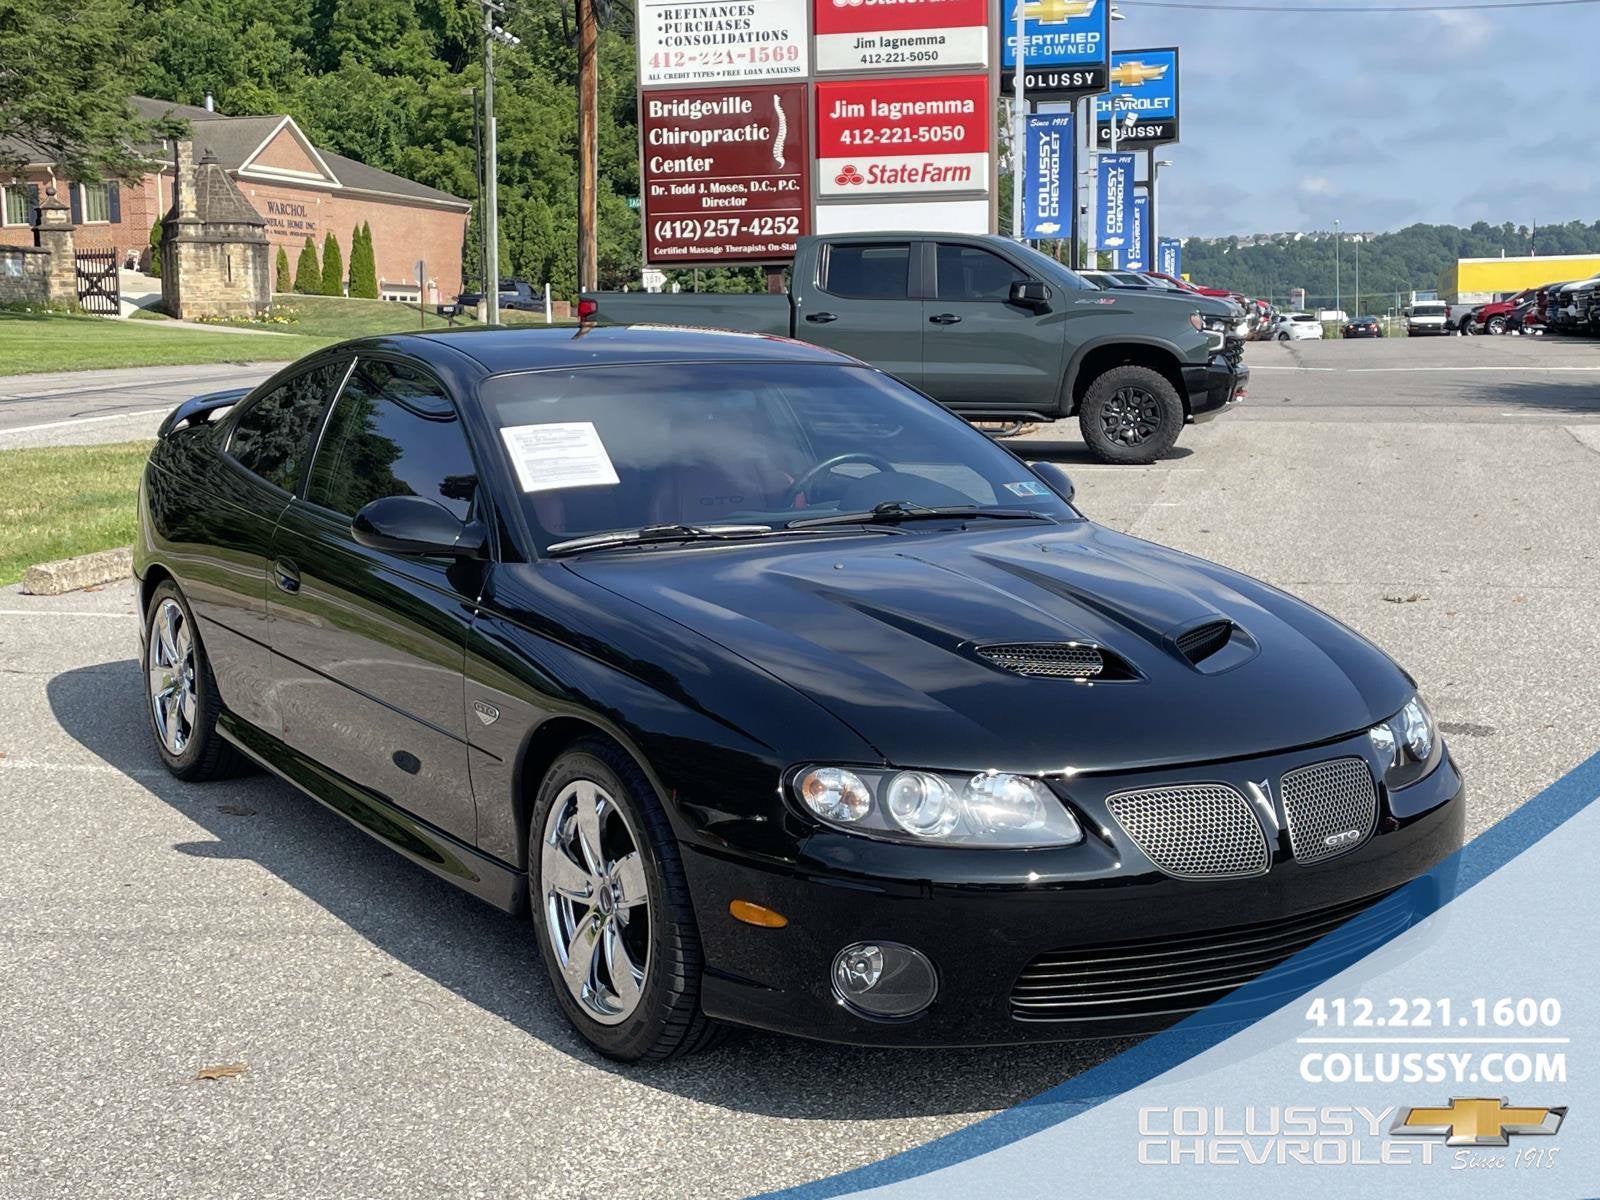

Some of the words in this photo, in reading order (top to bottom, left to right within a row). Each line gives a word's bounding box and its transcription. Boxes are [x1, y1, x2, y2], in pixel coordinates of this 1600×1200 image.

[664, 5, 755, 20] REFINANCES
[664, 18, 751, 34] PURCHASES
[665, 29, 789, 47] CONSOLIDATIONS
[853, 37, 876, 50] Jim
[880, 35, 946, 49] Iagnemma
[648, 45, 799, 68] 412-221-1569
[860, 50, 939, 64] 412-221-5050
[664, 72, 690, 80] CREDIT
[722, 69, 740, 77] FREE
[766, 66, 801, 74] ANALYSIS
[649, 96, 752, 119] Bridgeville
[829, 100, 865, 119] Jim
[871, 98, 975, 120] Iagnemma
[1030, 118, 1049, 127] Since
[1052, 117, 1069, 126] 1918
[649, 123, 770, 147] Chiropractic
[840, 125, 965, 145] 412-221-5050
[650, 156, 714, 174] Center
[1038, 131, 1051, 217] COLUSSY
[1050, 131, 1060, 217] CHEVROLET
[651, 185, 668, 196] Dr.
[669, 183, 696, 195] Todd
[698, 183, 708, 194] J.
[710, 182, 748, 194] Moses,
[750, 180, 777, 193] D.C.,
[778, 179, 800, 191] P.C.
[702, 197, 748, 208] Director
[1106, 167, 1117, 234] COLUSSY
[267, 201, 308, 218] WARCHOL
[653, 245, 688, 255] Certified
[689, 245, 723, 254] Massage
[725, 244, 766, 253] Therapists
[1325, 829, 1360, 845] GTO
